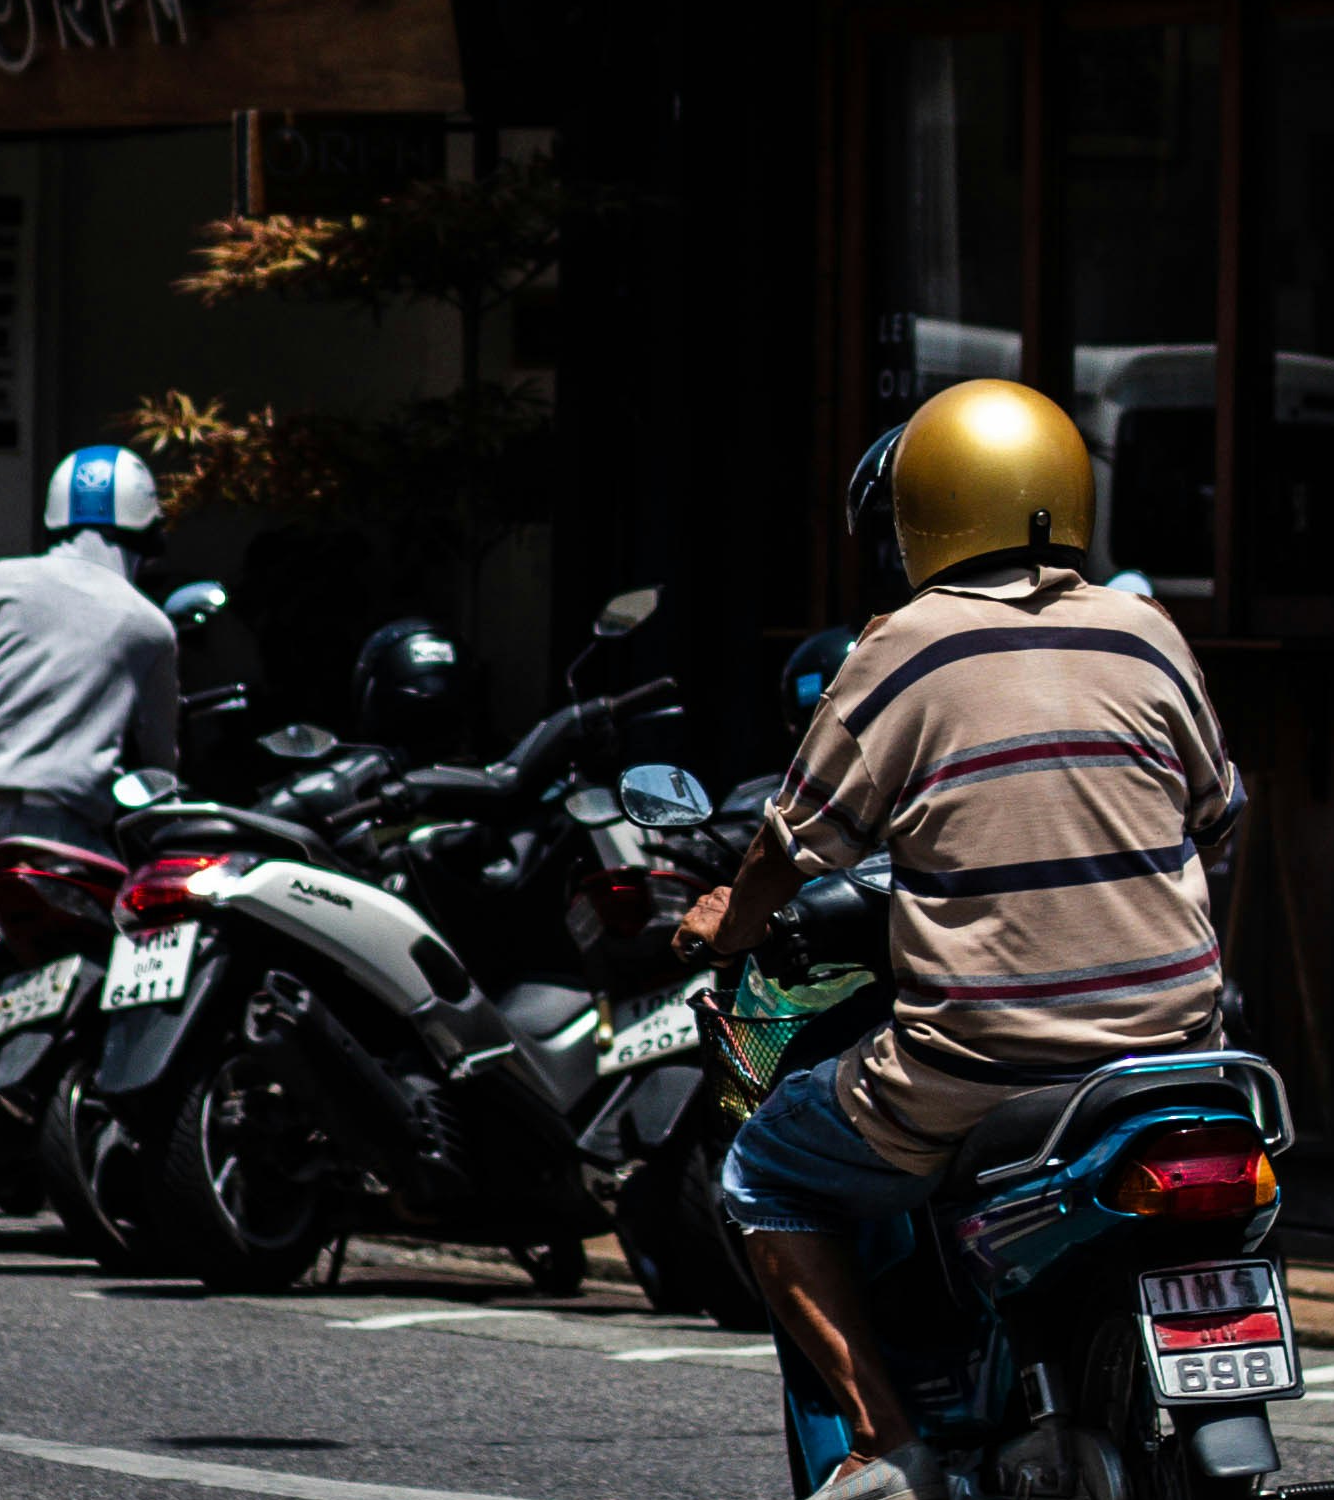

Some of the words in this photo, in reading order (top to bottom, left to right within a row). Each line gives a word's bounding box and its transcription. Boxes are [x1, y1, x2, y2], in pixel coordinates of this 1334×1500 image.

[110, 977, 174, 1007] 6411
[618, 1026, 693, 1063] 6207
[1176, 1351, 1275, 1393] 698
